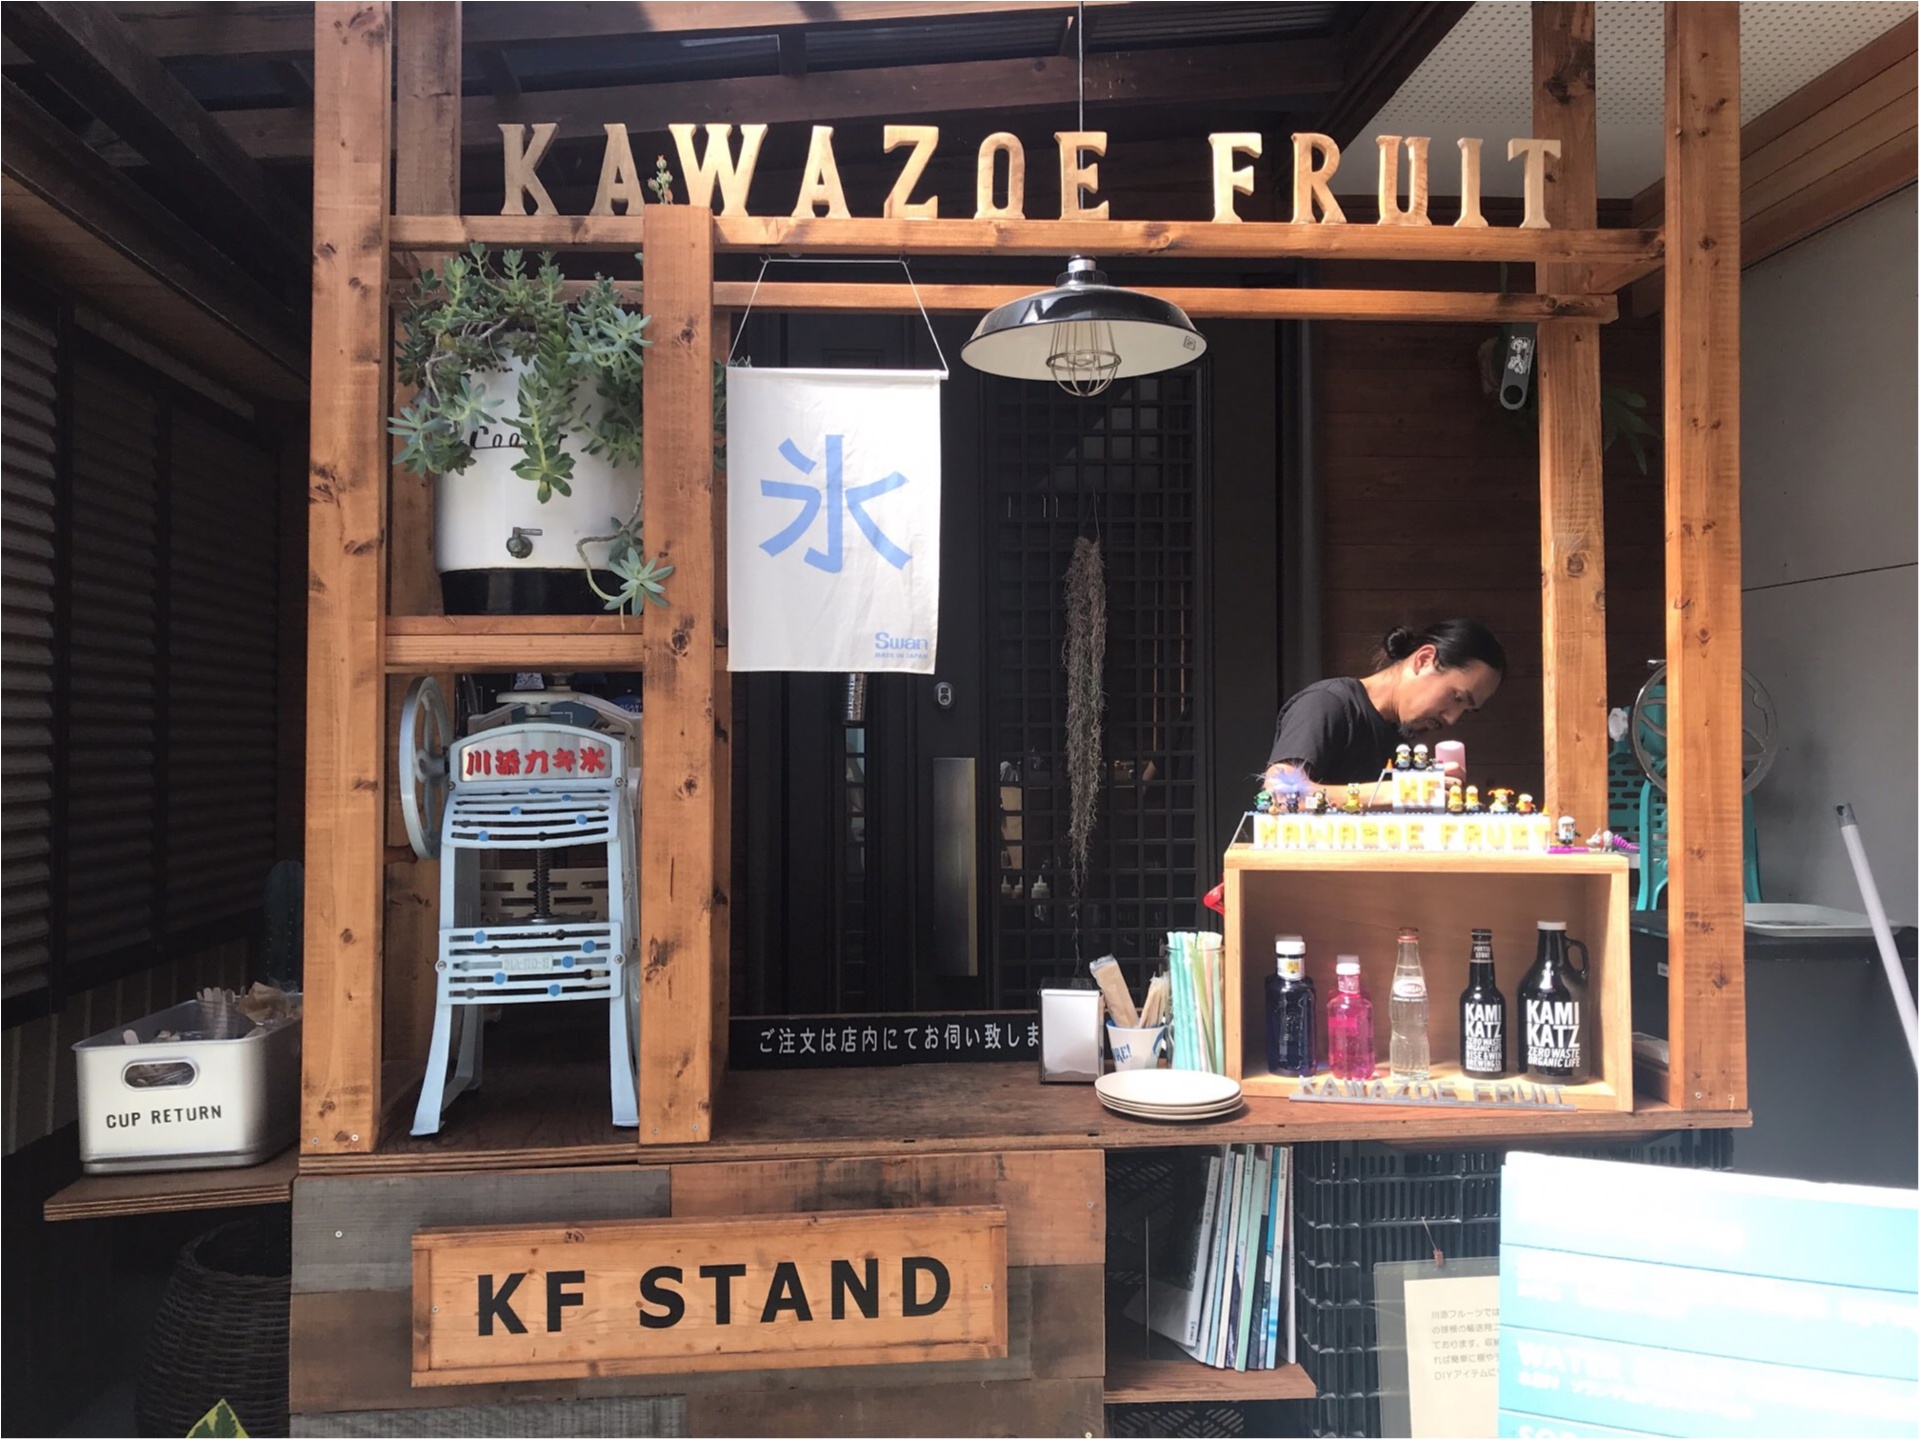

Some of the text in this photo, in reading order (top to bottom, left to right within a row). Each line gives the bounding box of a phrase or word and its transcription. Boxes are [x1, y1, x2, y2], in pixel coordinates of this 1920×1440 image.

[498, 123, 1562, 229] KAWAZOE FRUIT
[758, 433, 912, 574] 氷
[874, 631, 929, 650] Swan
[1465, 1002, 1502, 1022] KAMI
[1526, 999, 1580, 1025] KAMI
[758, 1022, 1039, 1055] ご注文は店内にてお伺い致しま
[1465, 1021, 1502, 1039] KATZ
[1526, 1022, 1581, 1048] KATZ
[1527, 1047, 1580, 1059] ZERO WASTE
[1527, 1056, 1580, 1068] ORGANIC LIFE
[1297, 1075, 1568, 1105] KAWAZOE FRUIT
[106, 1104, 223, 1129] CUP RETURN
[477, 1256, 952, 1337] KF STAND
[1516, 1341, 1621, 1382] WATER
